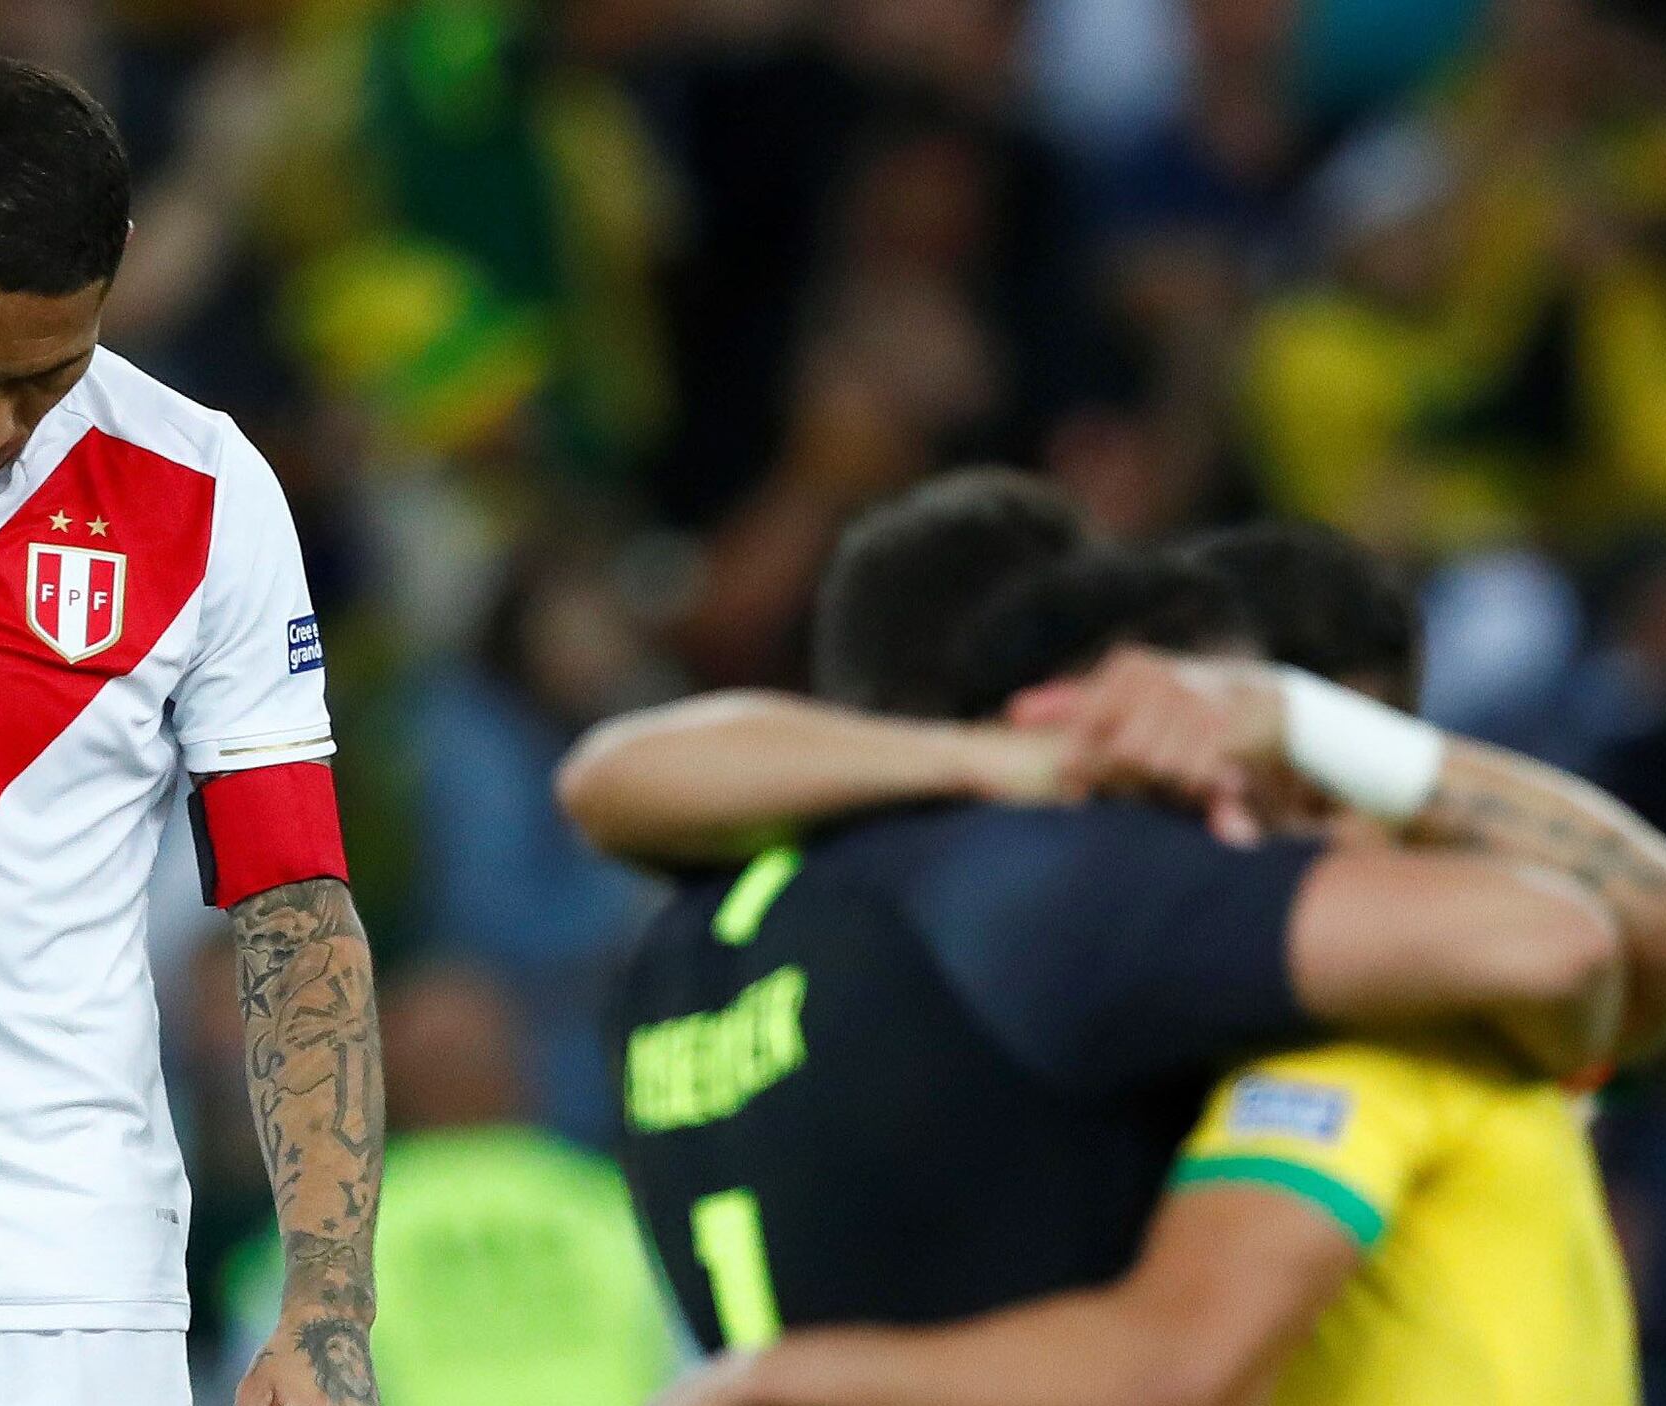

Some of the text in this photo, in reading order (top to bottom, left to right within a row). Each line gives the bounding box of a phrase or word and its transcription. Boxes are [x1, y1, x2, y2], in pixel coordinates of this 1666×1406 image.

[289, 623, 313, 644] Cree
[290, 639, 323, 670] grand
[689, 1186, 785, 1350] 1
